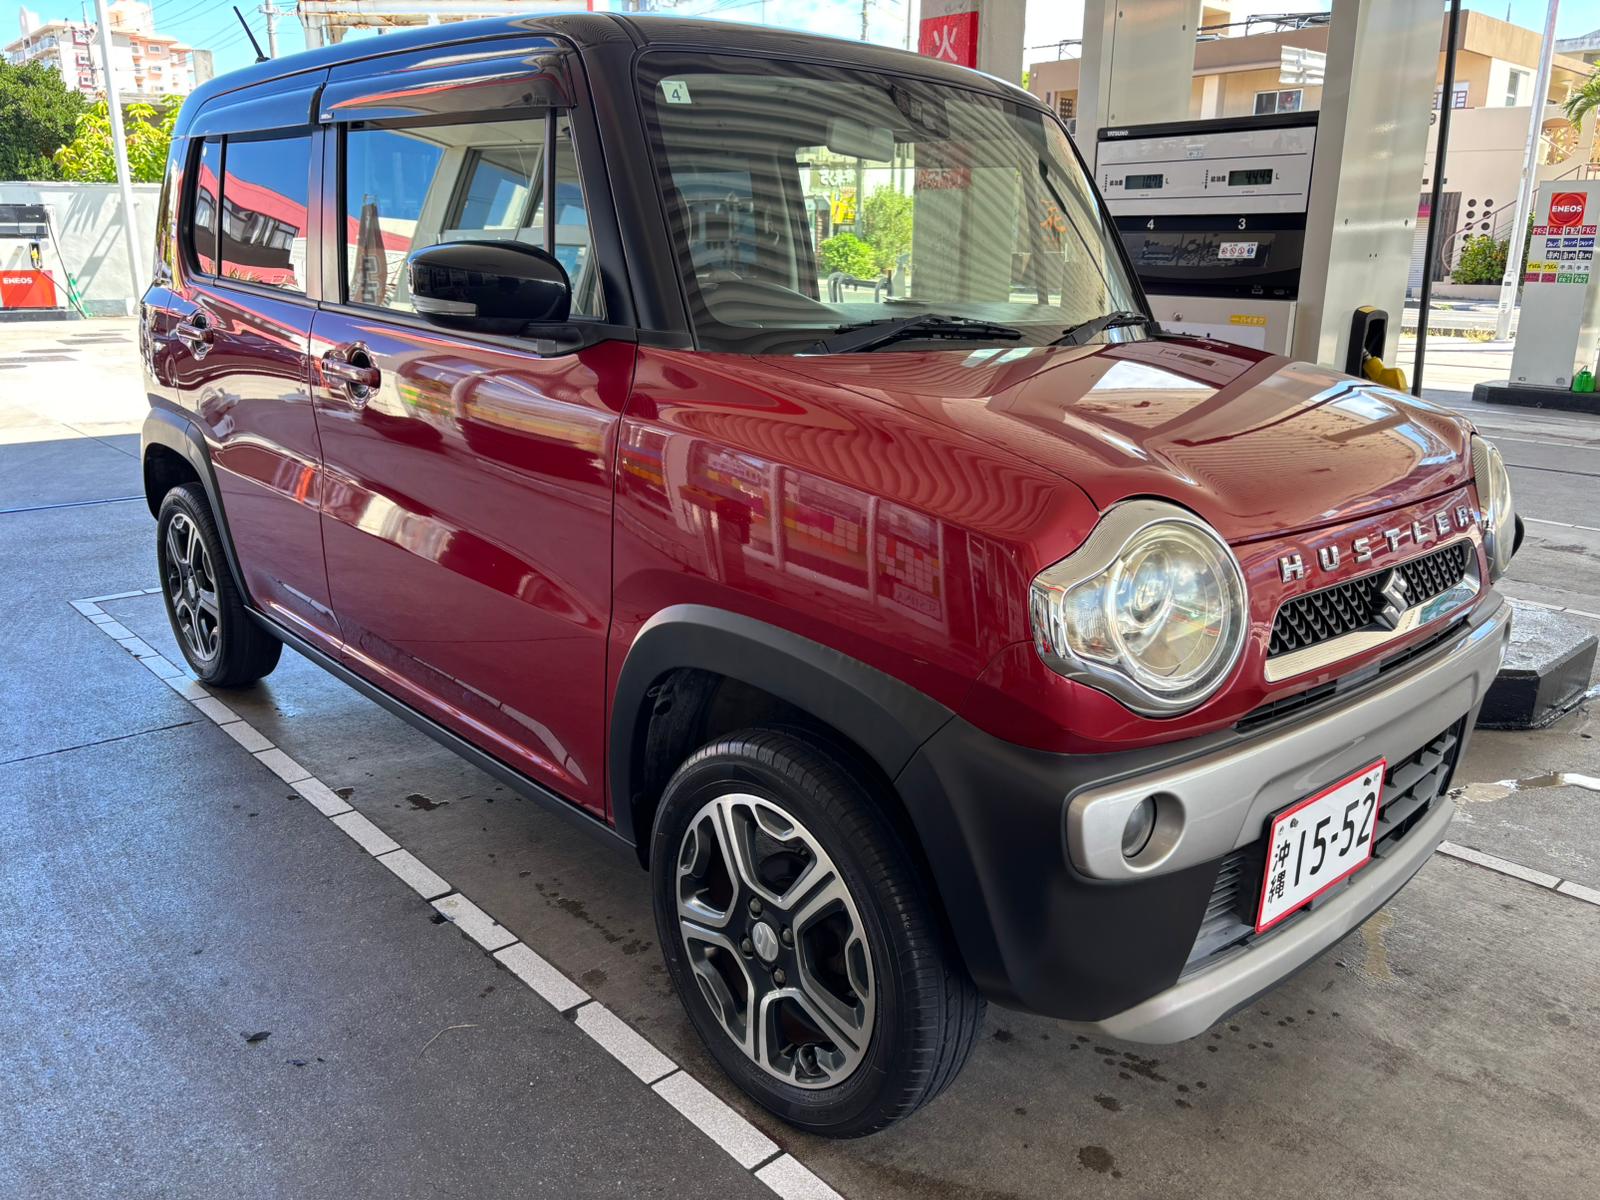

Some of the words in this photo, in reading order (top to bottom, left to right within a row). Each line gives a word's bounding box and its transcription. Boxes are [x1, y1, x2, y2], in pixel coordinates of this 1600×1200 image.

[932, 25, 958, 61] 火
[671, 88, 681, 101] 4
[1551, 205, 1583, 213] ENEOS
[1147, 219, 1155, 230] 4
[1238, 218, 1247, 230] 3
[1279, 504, 1470, 584] HUSTLER
[1294, 791, 1376, 887] 15-52
[1267, 839, 1290, 904] 沖縄
